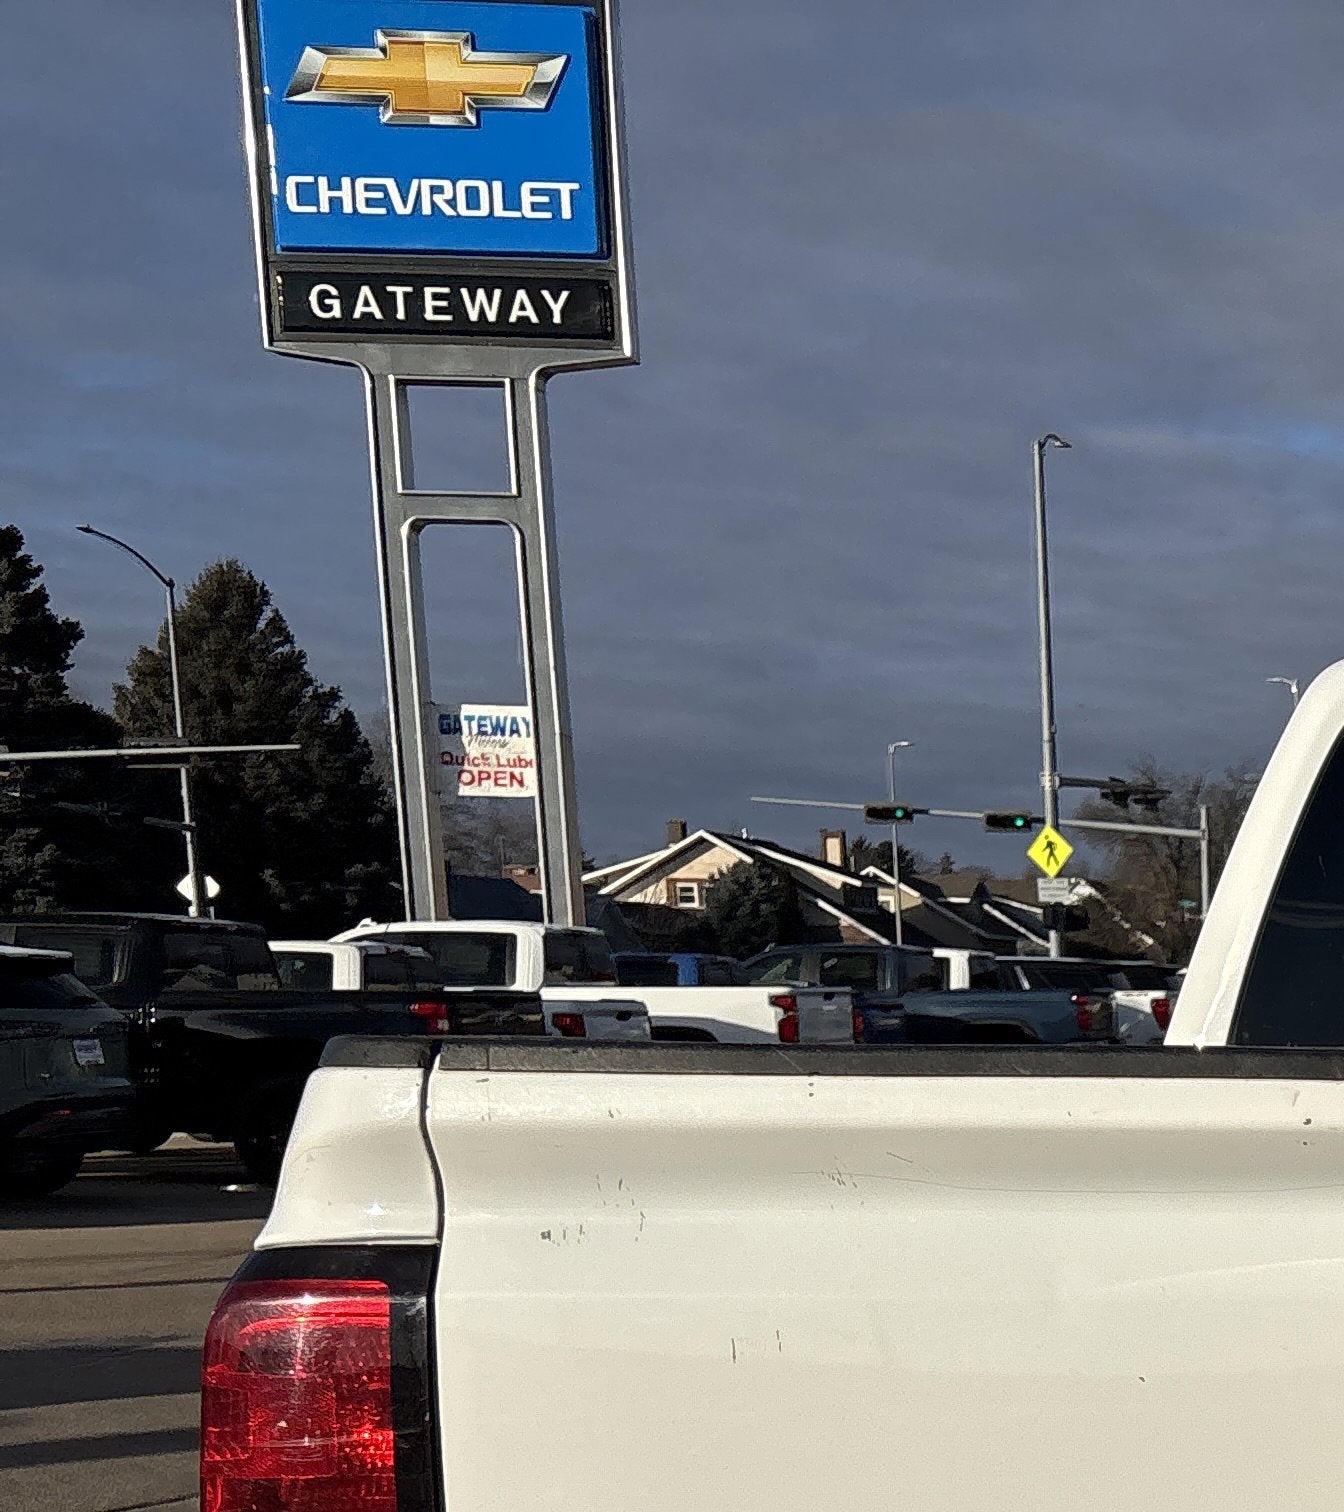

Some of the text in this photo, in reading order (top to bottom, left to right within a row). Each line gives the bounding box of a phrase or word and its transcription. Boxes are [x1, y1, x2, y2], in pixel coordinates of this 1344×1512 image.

[285, 175, 580, 220] CHEVROLET
[309, 284, 571, 325] GATEWAY
[457, 769, 525, 788] OPEN
